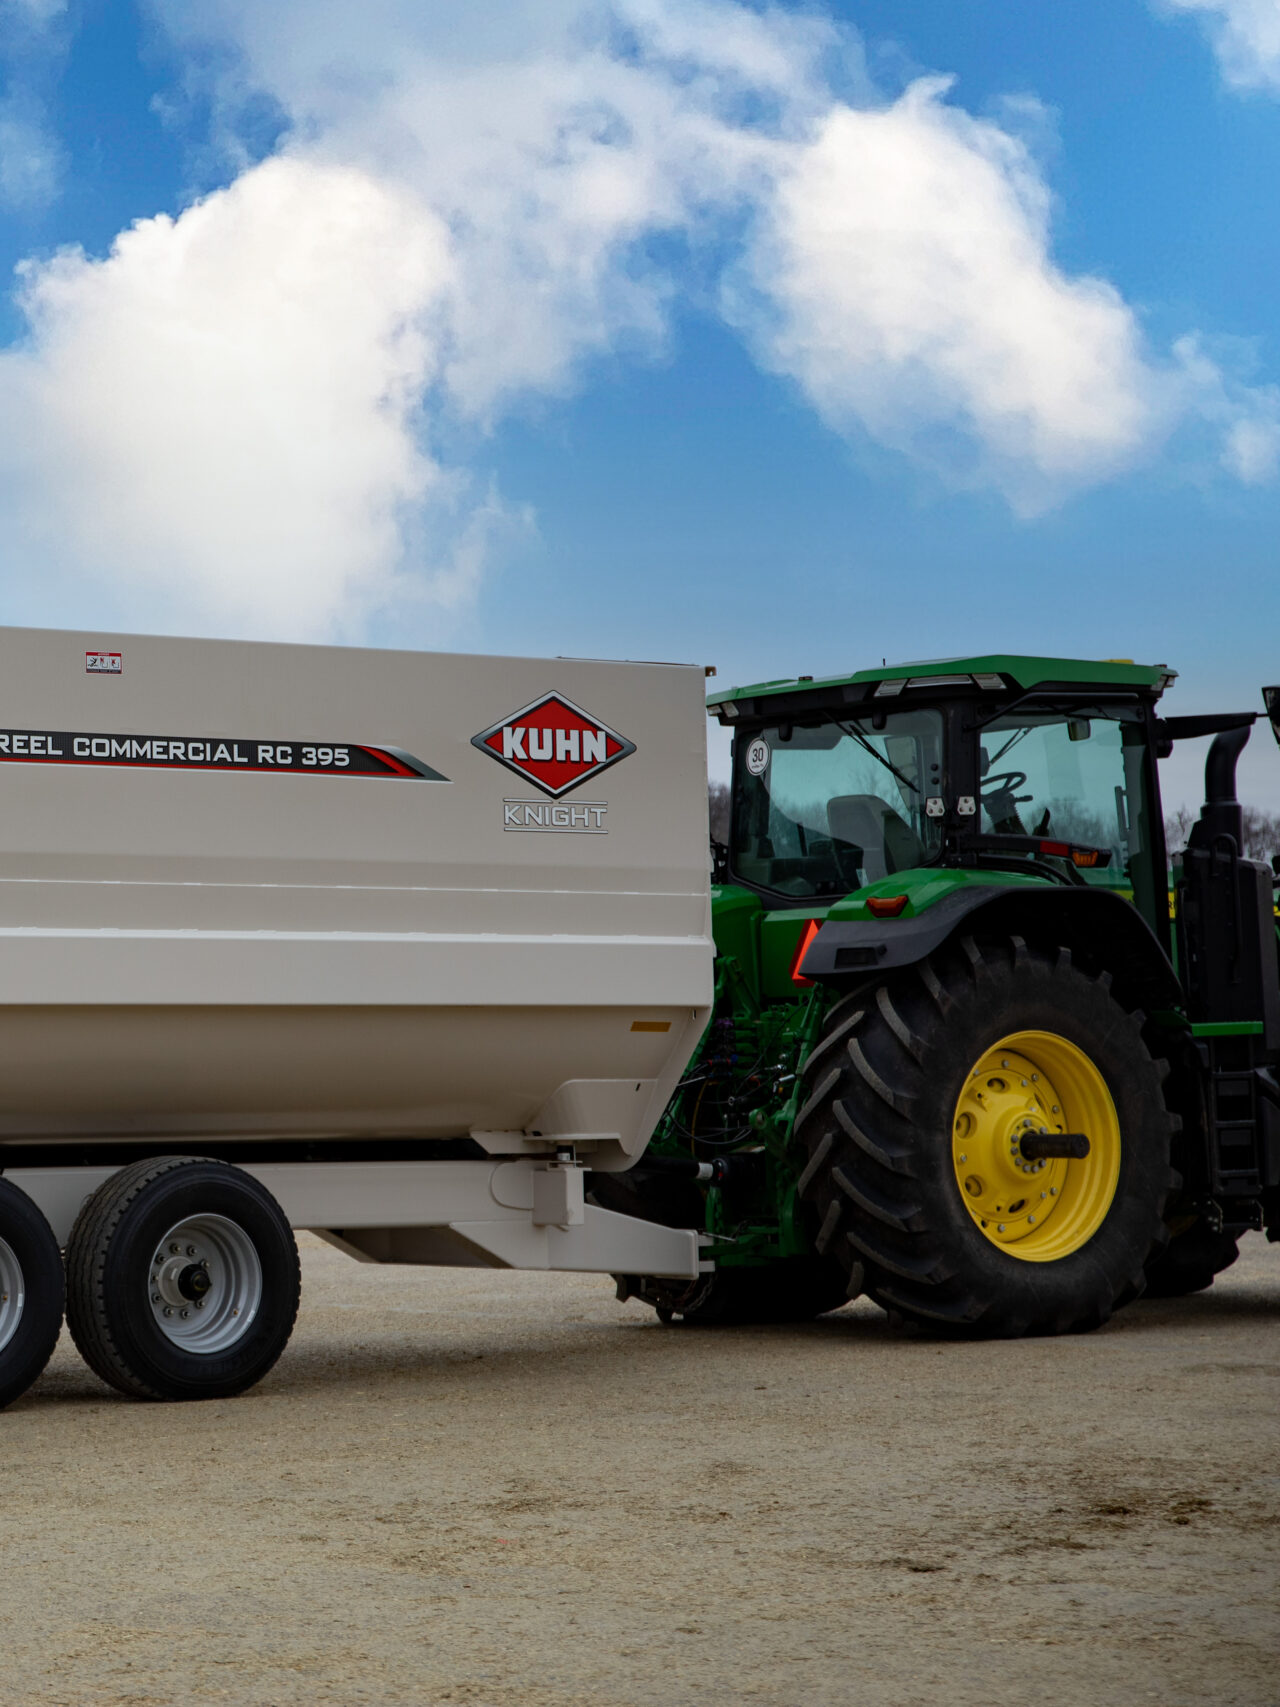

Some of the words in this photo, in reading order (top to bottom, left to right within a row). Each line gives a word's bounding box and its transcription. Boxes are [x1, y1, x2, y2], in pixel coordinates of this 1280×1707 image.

[73, 738, 249, 763] COMMERCIAL
[257, 745, 293, 765] RC
[301, 747, 350, 767] 395
[502, 727, 608, 763] KUHN
[752, 747, 764, 763] 30
[504, 805, 608, 828] KNIGHT
